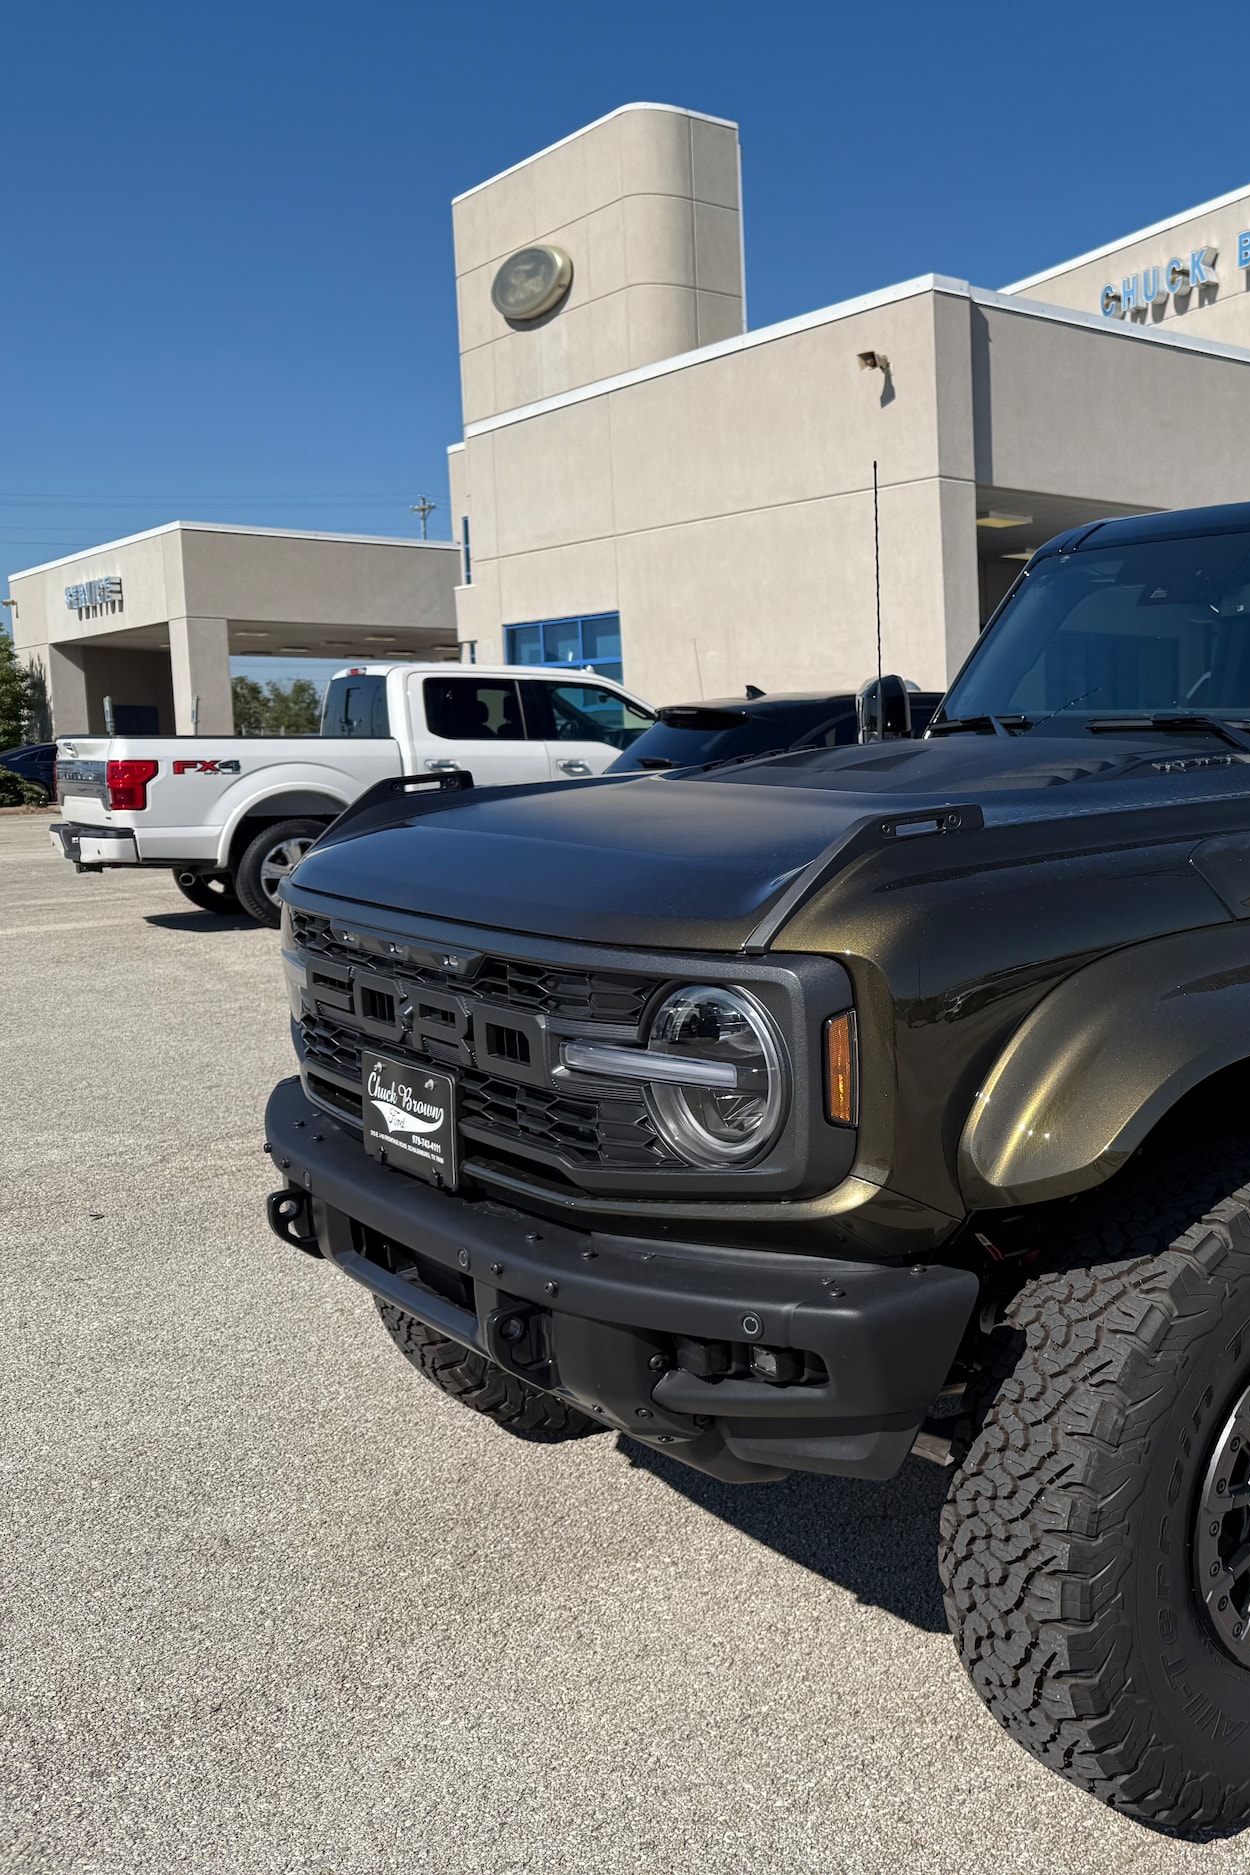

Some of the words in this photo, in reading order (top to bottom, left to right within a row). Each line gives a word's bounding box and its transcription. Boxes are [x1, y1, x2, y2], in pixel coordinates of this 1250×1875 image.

[1100, 247, 1217, 318] CHUCK
[172, 759, 242, 775] FX4
[304, 954, 552, 1092] FORD
[367, 1071, 398, 1105] Chuck
[397, 1084, 444, 1121] Brown
[387, 1107, 406, 1129] Ford
